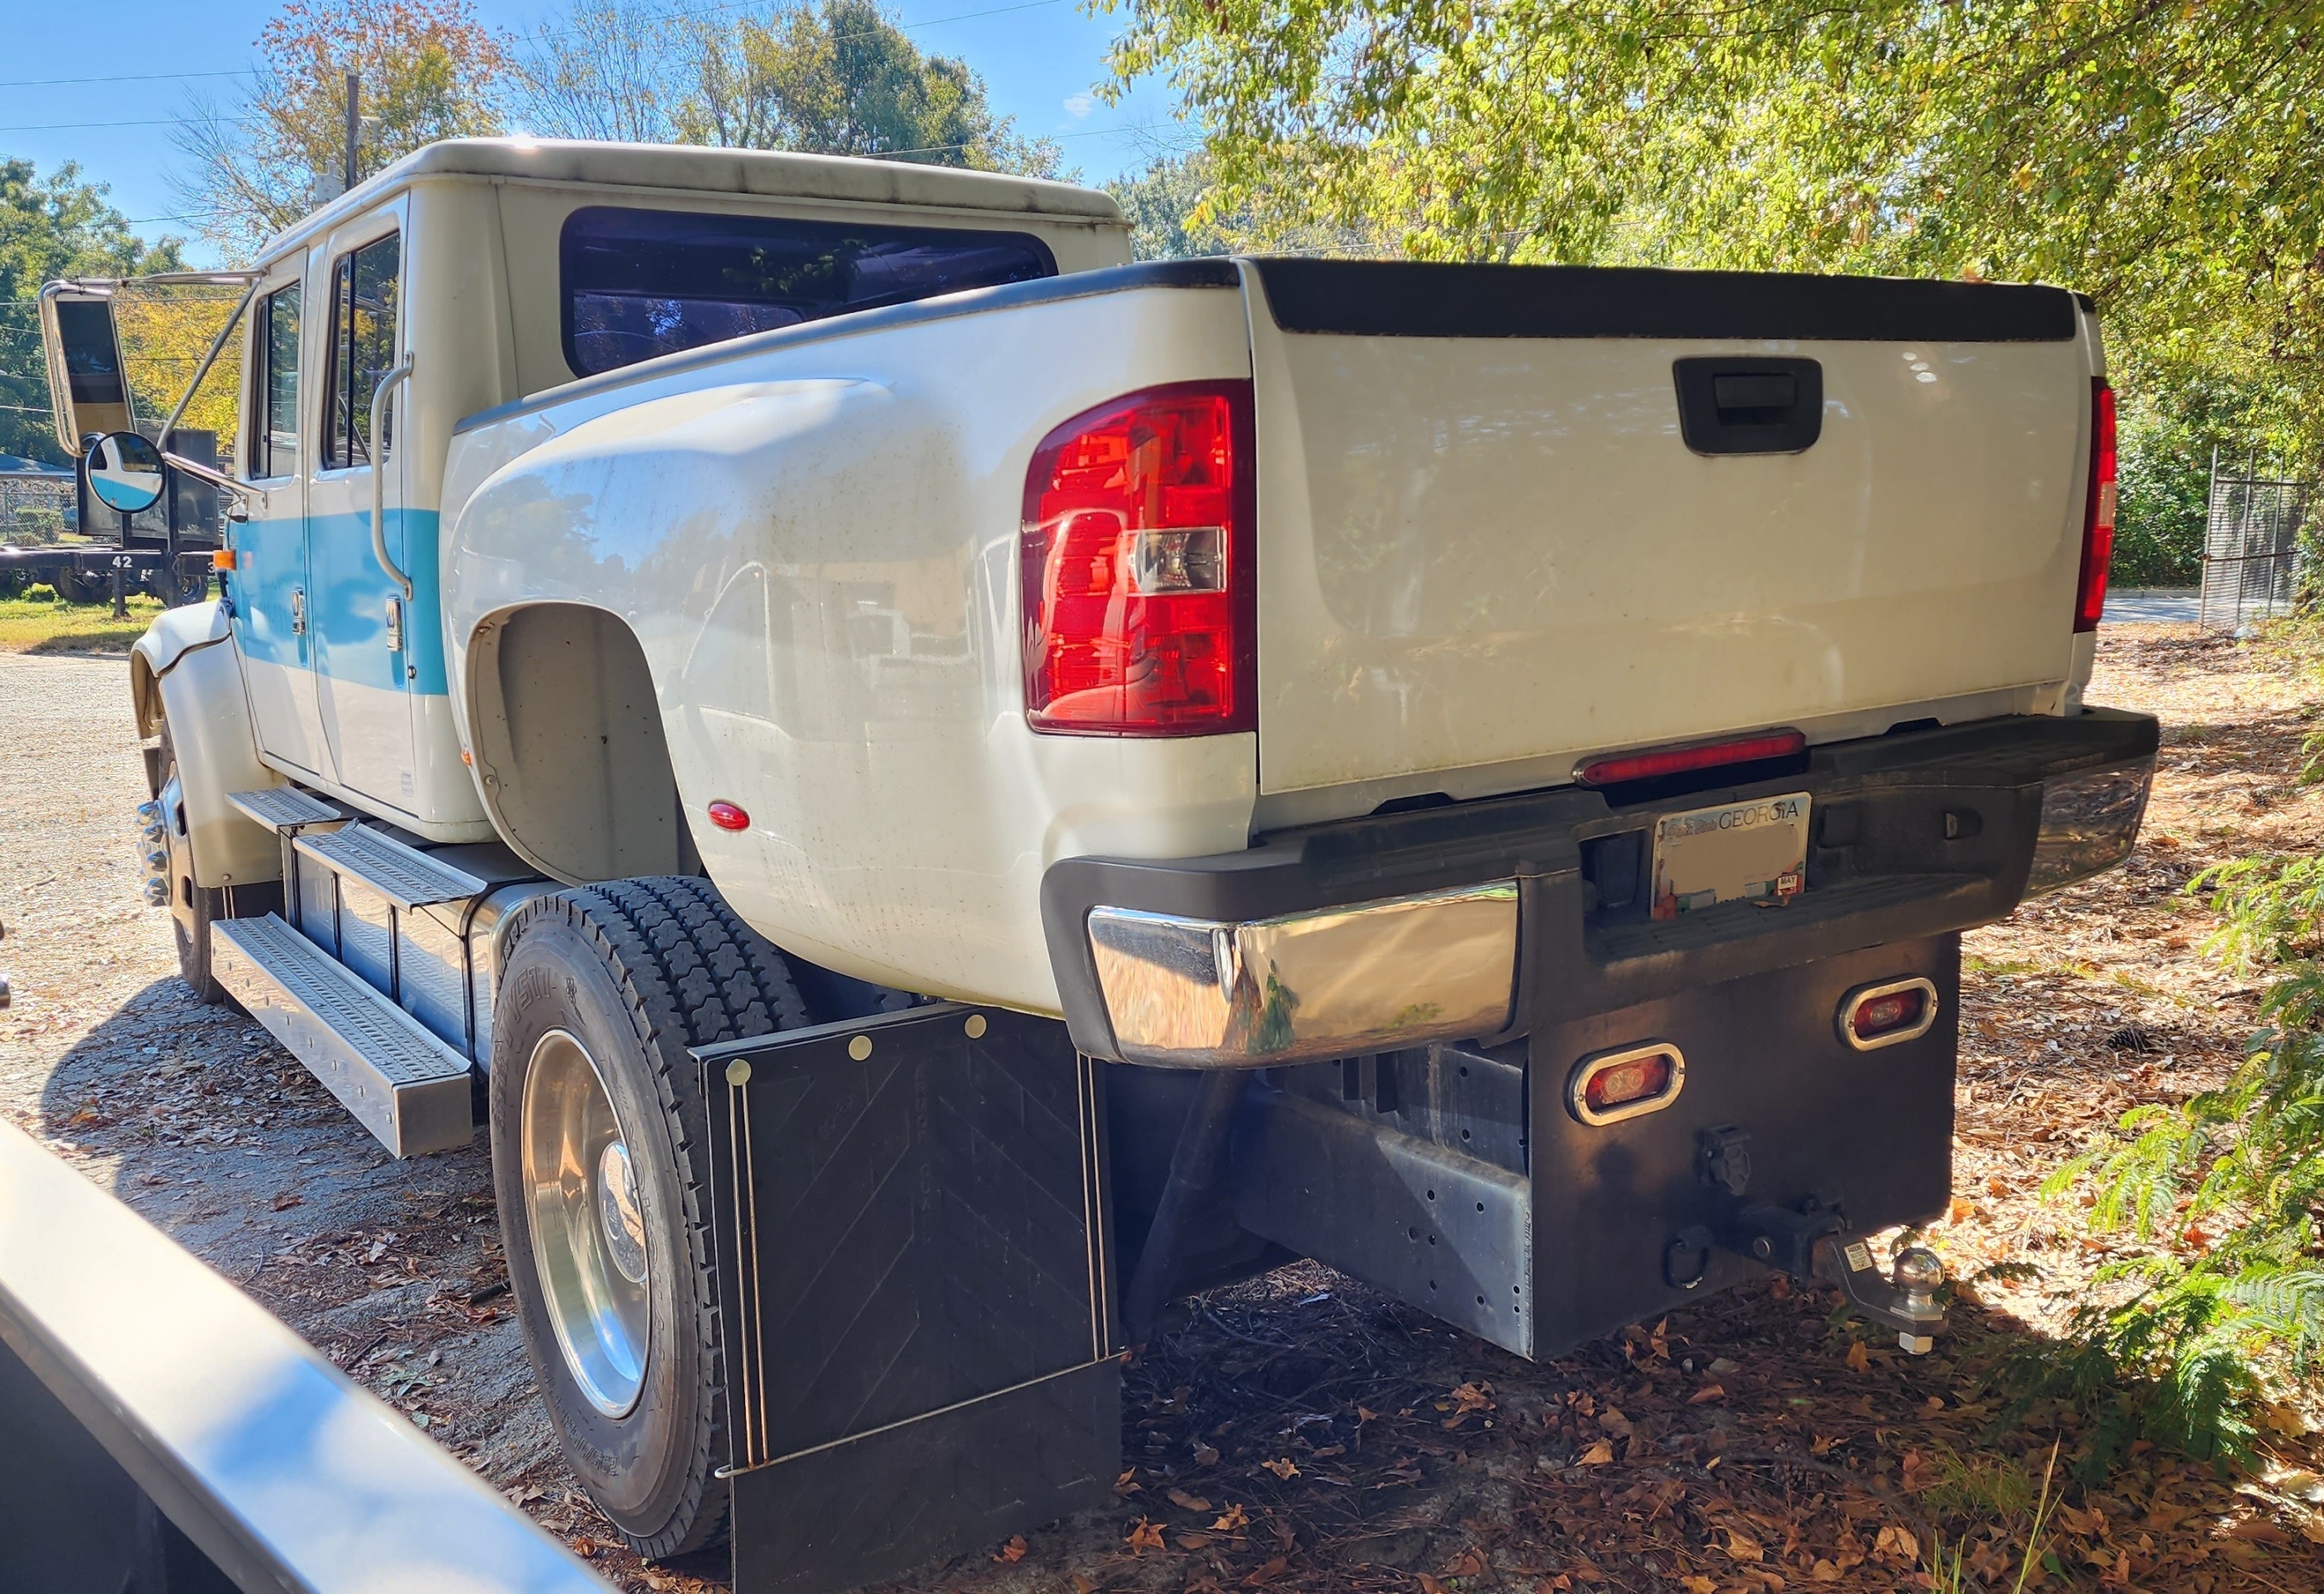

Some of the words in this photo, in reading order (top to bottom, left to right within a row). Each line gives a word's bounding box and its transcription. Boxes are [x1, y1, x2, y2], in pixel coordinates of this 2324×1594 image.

[112, 556, 132, 568] 42
[1718, 801, 1799, 830] GEORGIA
[1780, 875, 1796, 885] MAY
